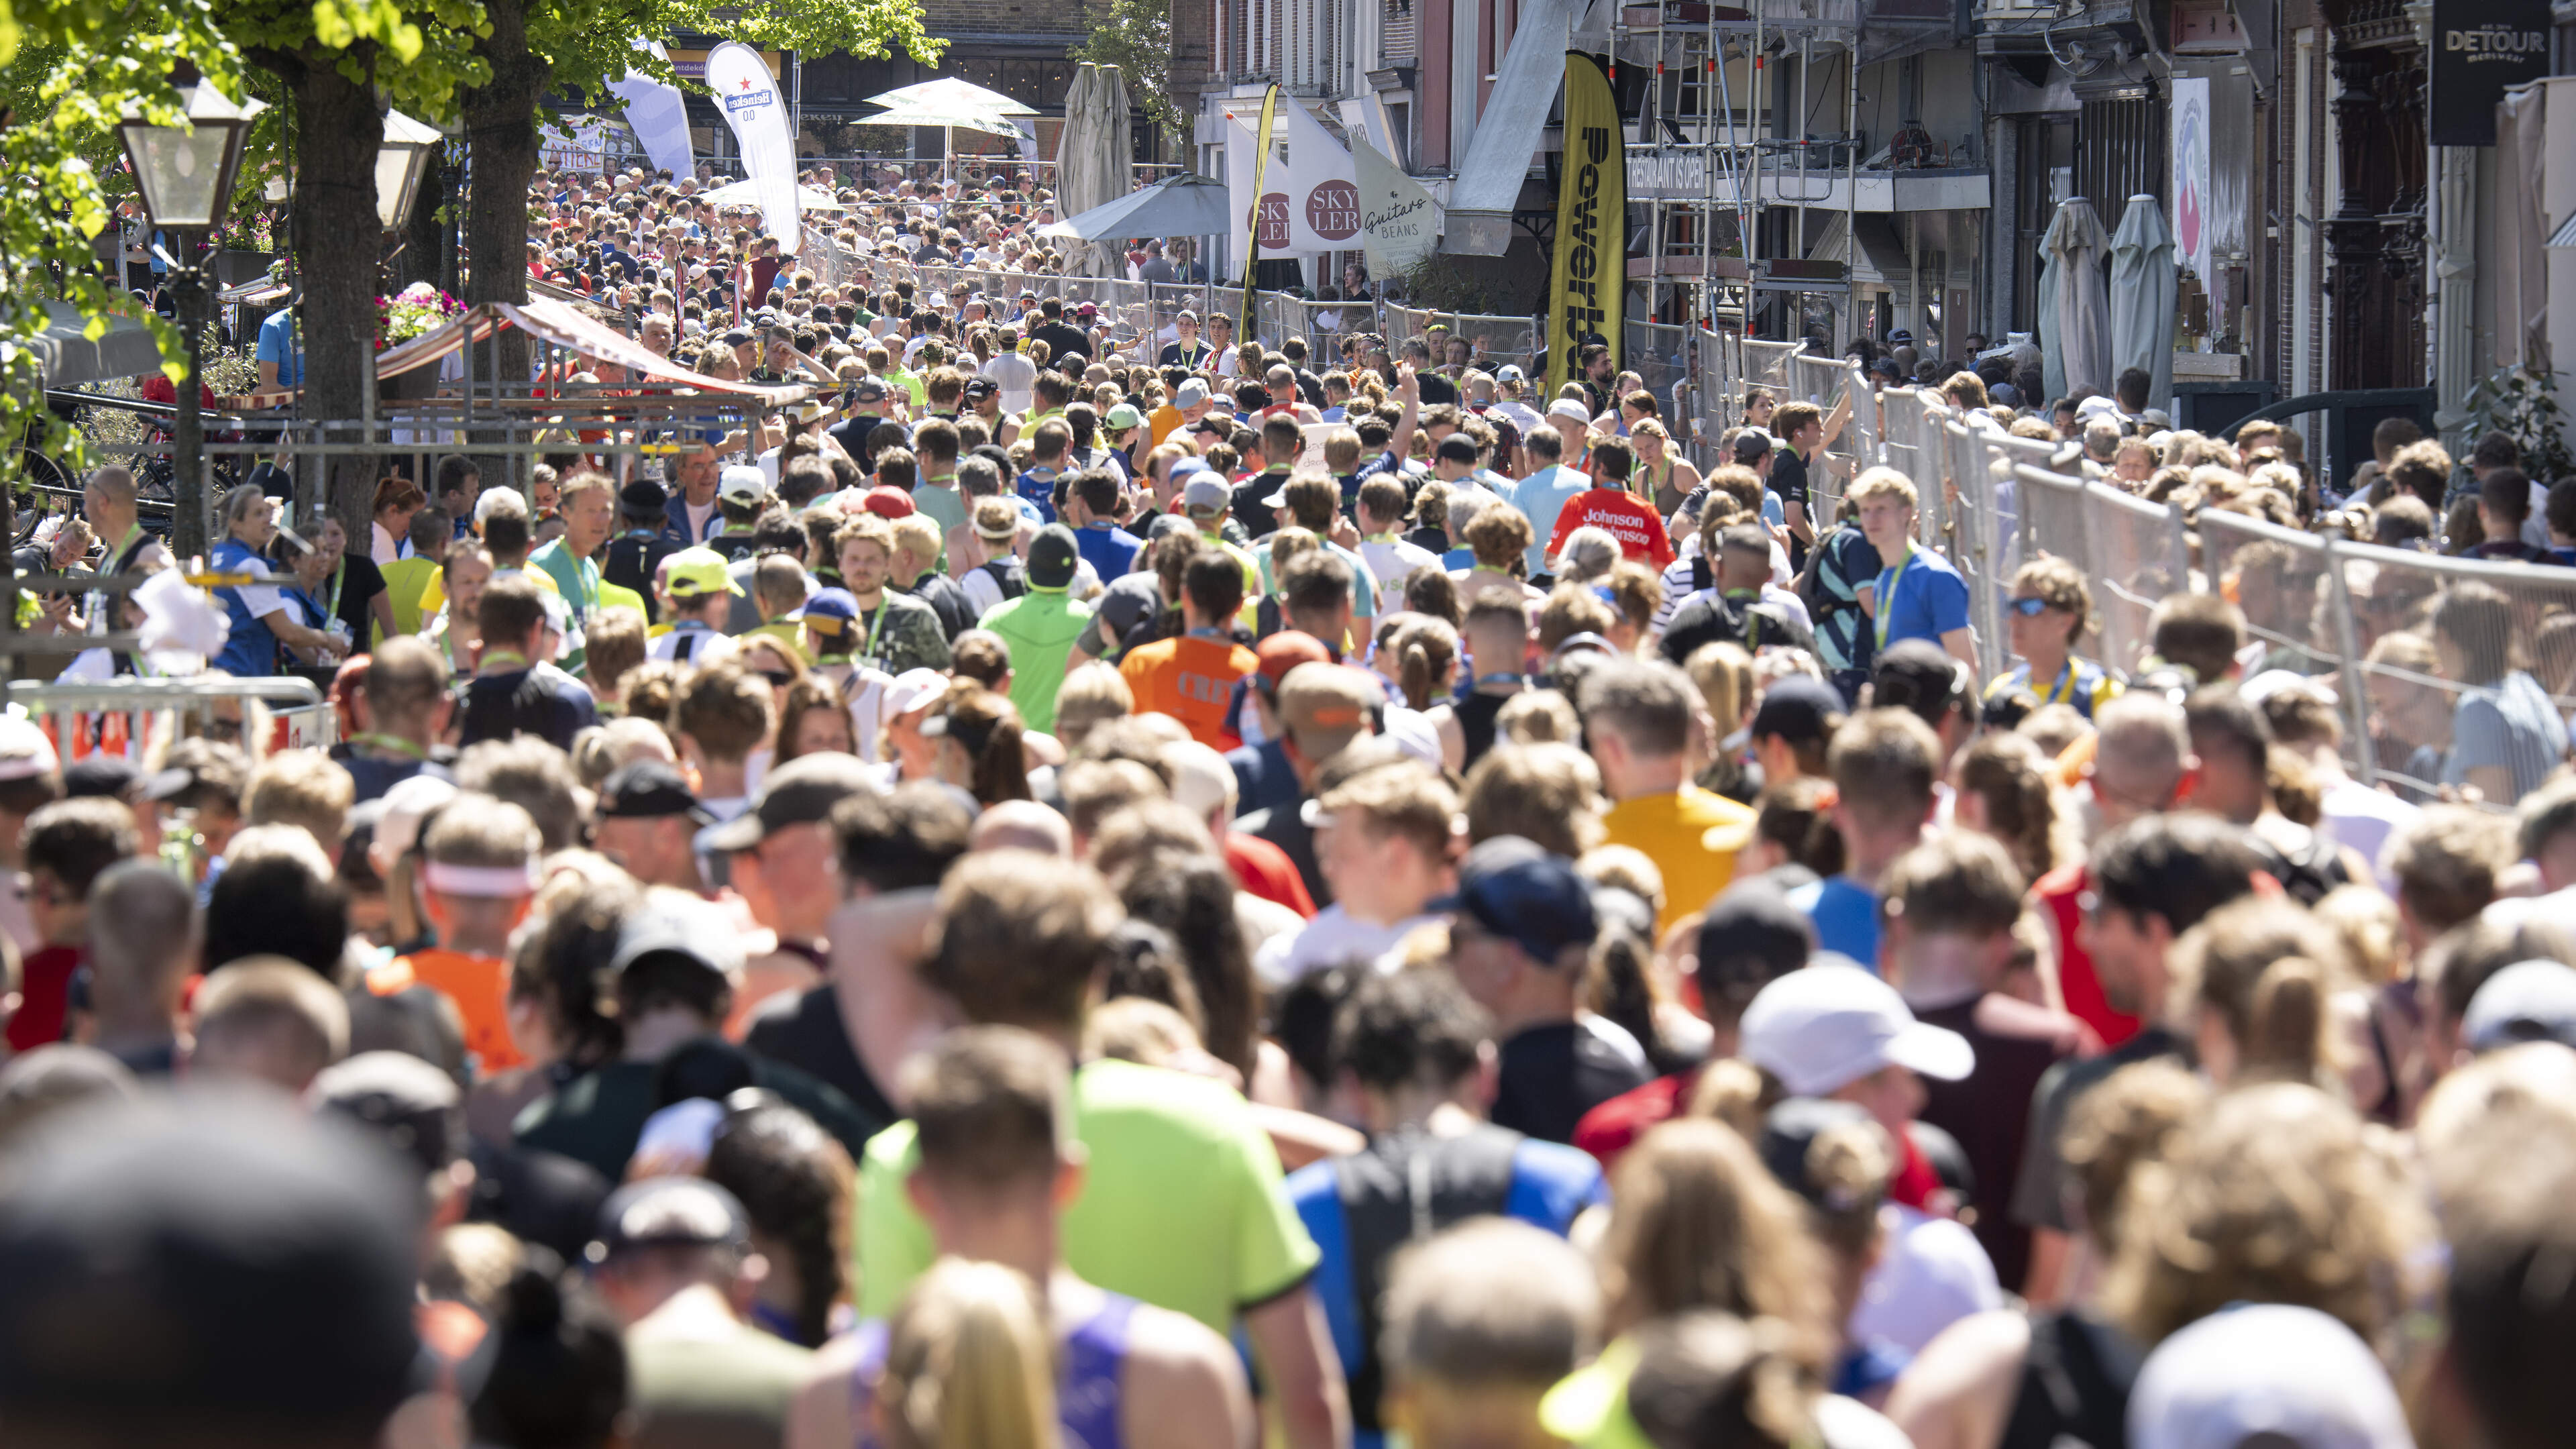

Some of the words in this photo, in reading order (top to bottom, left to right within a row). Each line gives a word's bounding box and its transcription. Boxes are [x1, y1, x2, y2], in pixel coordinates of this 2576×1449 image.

[2446, 30, 2545, 52] DETOUR
[674, 64, 704, 72] ntdekd
[2467, 52, 2525, 64] menswear
[1632, 156, 1674, 189] RESTAURANT
[1676, 156, 1683, 189] IS
[1684, 156, 1704, 189] OPEN
[1313, 189, 1358, 209] SKY
[1313, 211, 1358, 231] LER
[1364, 198, 1427, 234] Guitars
[1381, 223, 1419, 239] BEANS
[1582, 508, 1644, 529] Johnson
[1600, 524, 1650, 545] hnson
